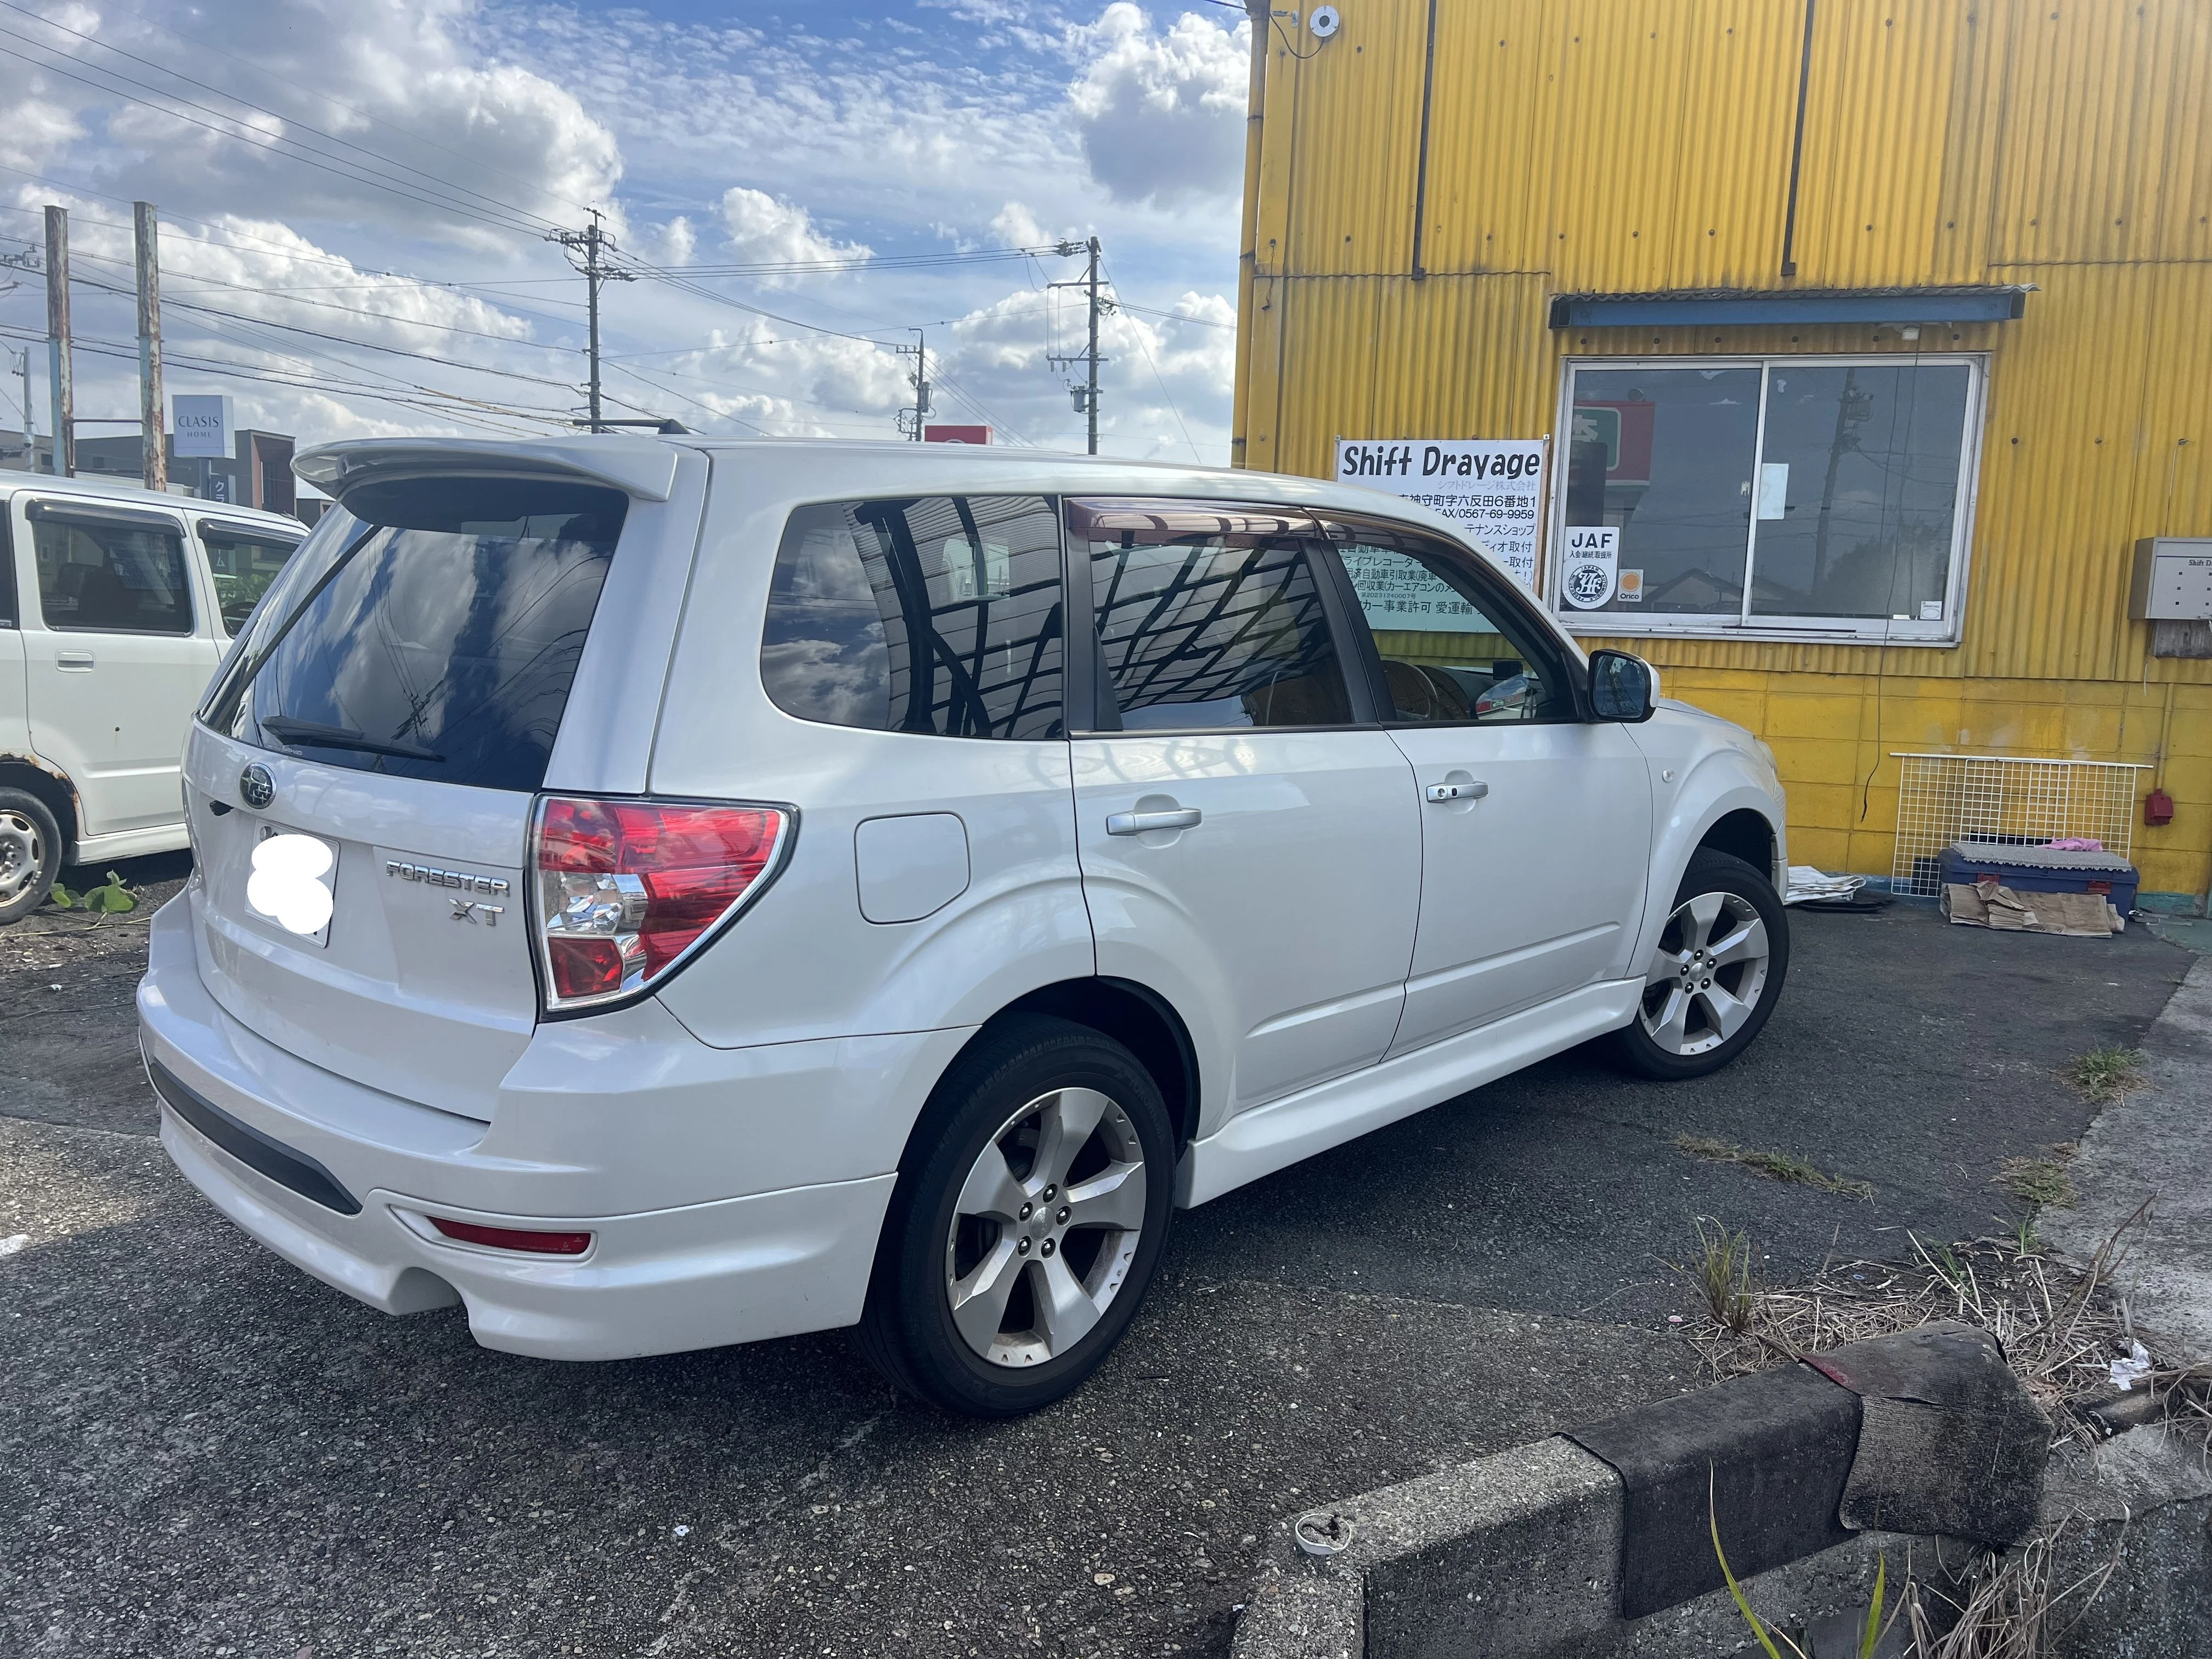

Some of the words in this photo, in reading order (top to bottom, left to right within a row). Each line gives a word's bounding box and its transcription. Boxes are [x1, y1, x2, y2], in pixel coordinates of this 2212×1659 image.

[178, 416, 219, 427] CLASIS
[1342, 445, 1412, 476] Shift
[1422, 446, 1540, 480] Drayage
[1437, 480, 1537, 491] シフトドレージ株式会社
[1398, 494, 1536, 507] 神守町字六反田6番地1
[1571, 533, 1613, 549] JAF
[1359, 599, 1432, 613] カー事業許可
[386, 860, 511, 898] FORESTER
[448, 898, 505, 927] XT
